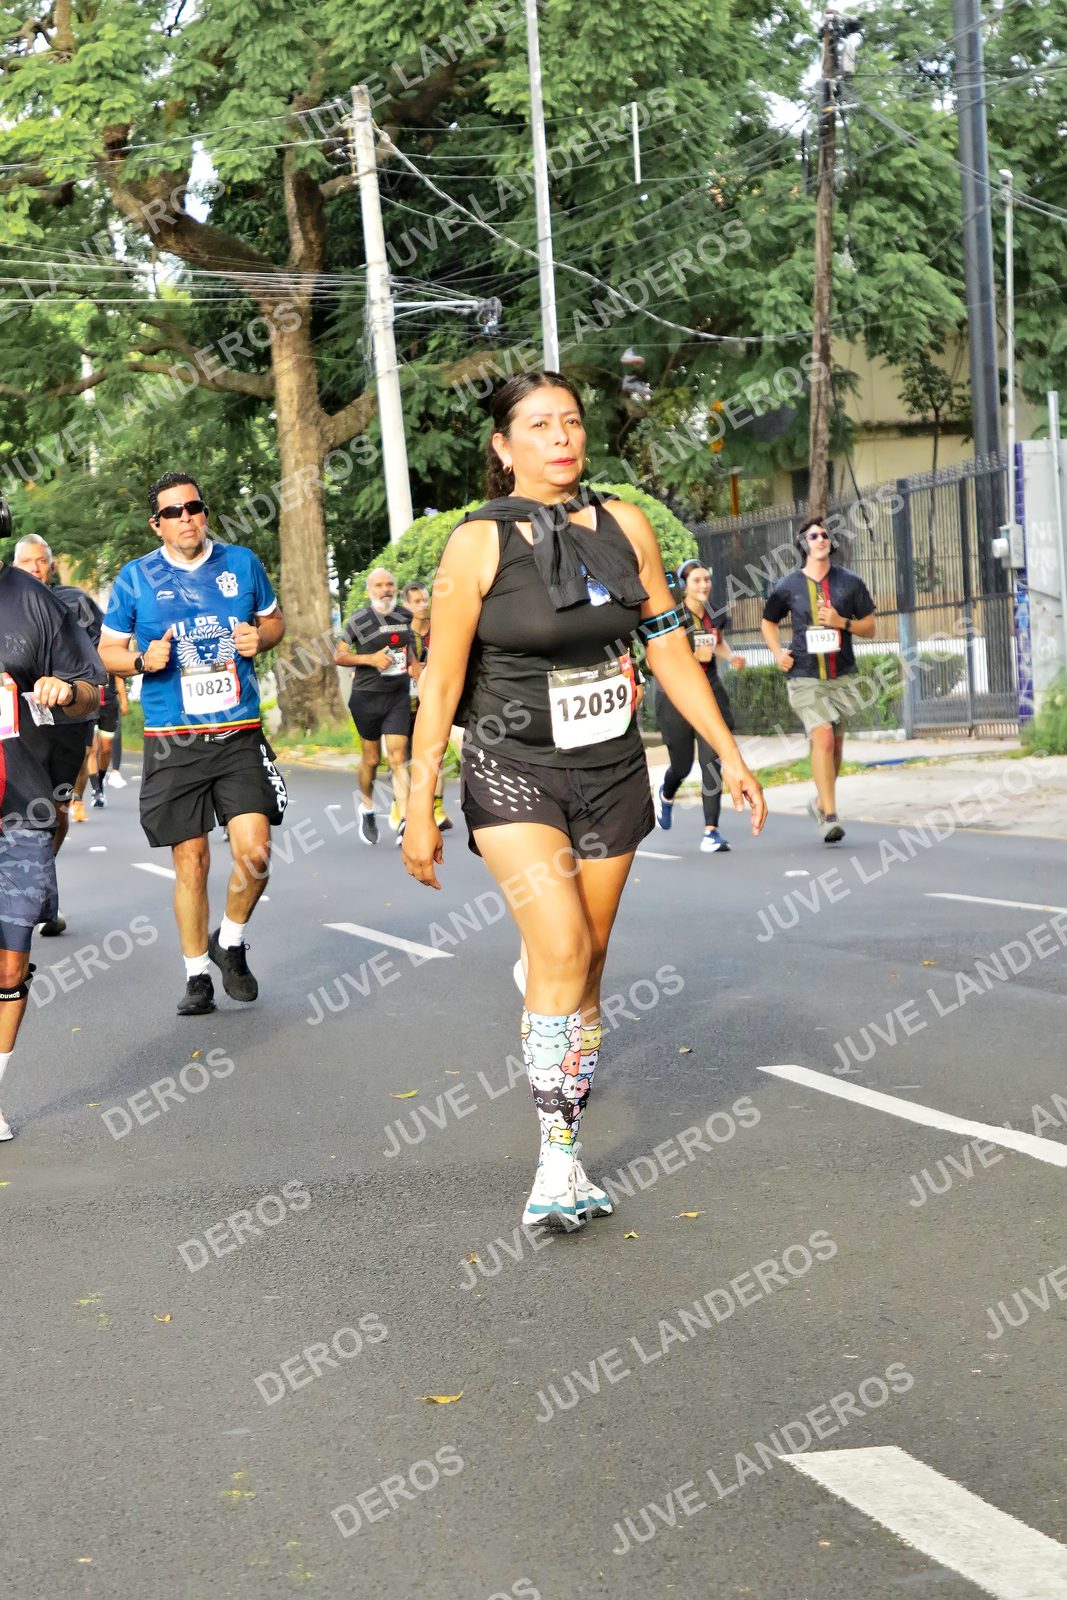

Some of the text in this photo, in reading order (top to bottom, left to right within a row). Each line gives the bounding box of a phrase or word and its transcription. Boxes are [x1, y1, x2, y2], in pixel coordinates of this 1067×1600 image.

[194, 615, 220, 627] DE
[809, 632, 837, 643] 11937
[185, 677, 232, 698] 10823
[557, 684, 628, 722] 12039
